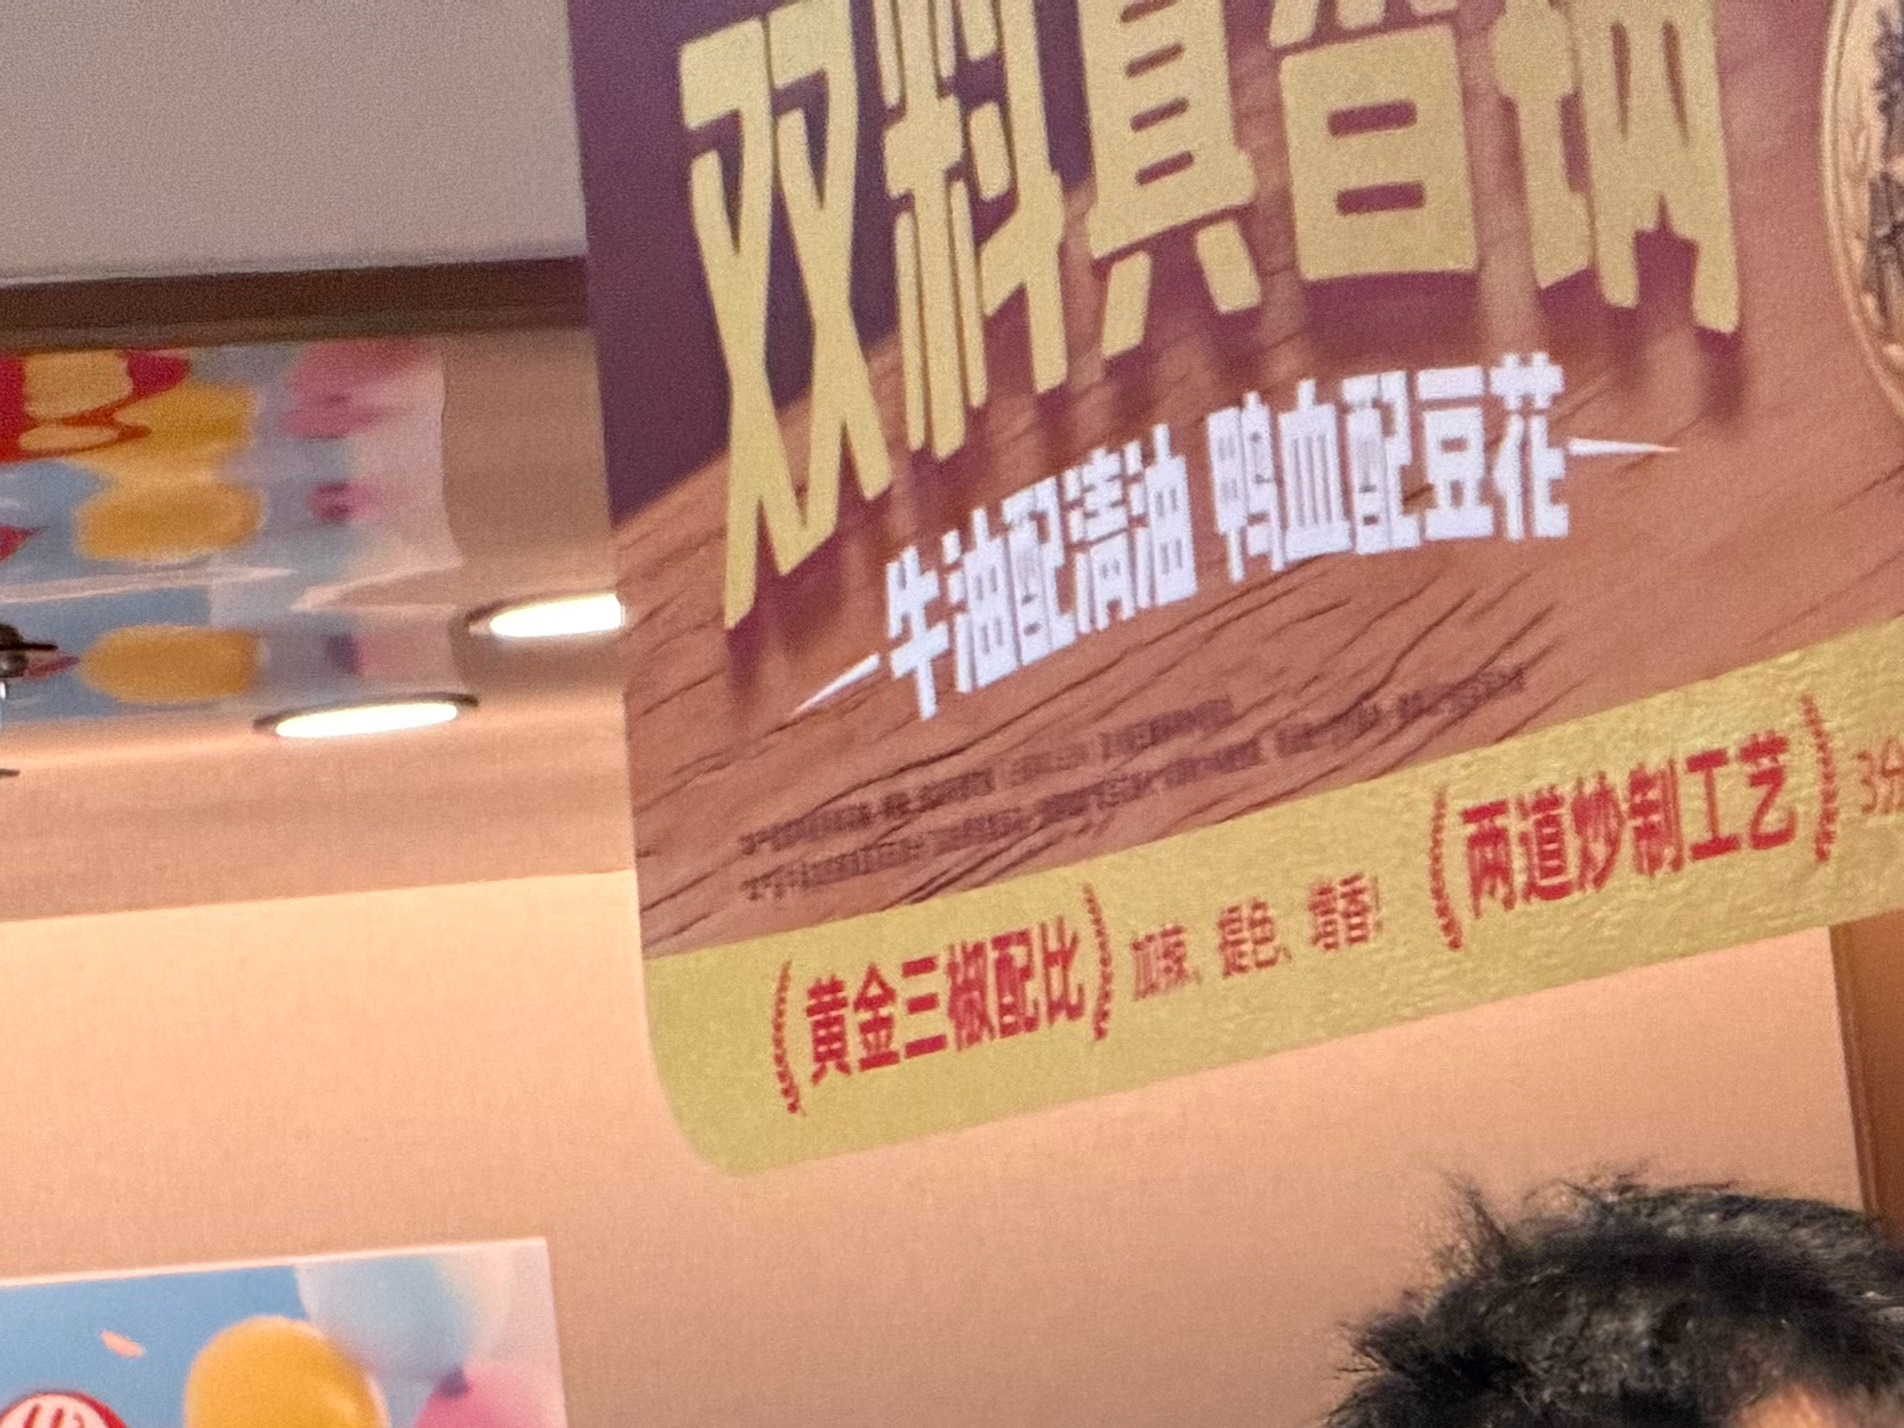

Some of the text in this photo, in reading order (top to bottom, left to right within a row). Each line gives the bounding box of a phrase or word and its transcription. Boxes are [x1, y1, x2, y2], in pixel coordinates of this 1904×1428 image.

[884, 351, 1569, 720] 牛油配清油 鸭血配豆花
[1459, 729, 1797, 920] 两道炒制工艺
[805, 914, 1089, 1084] 黄金三椒配比
